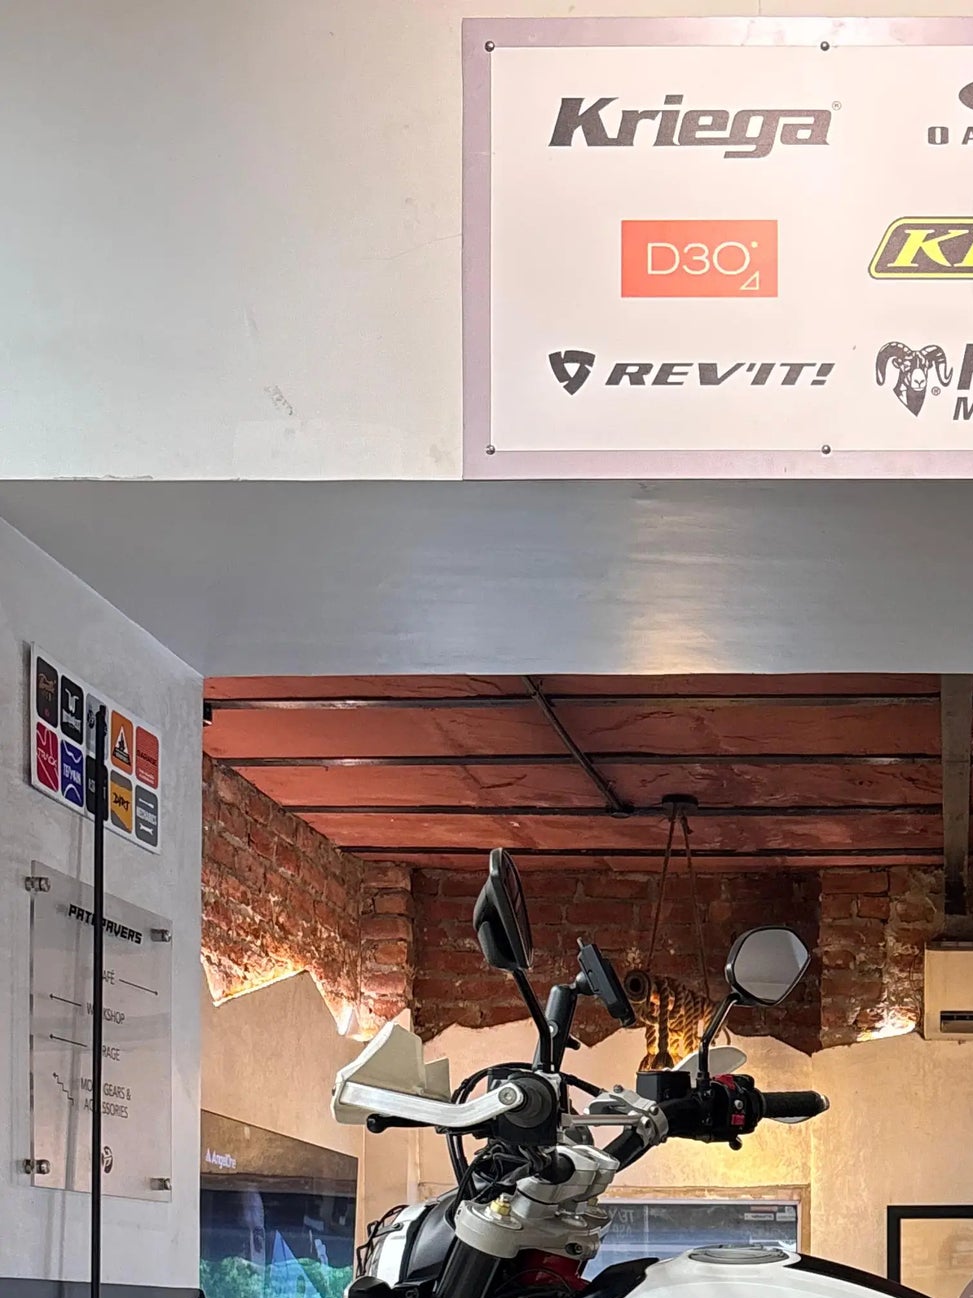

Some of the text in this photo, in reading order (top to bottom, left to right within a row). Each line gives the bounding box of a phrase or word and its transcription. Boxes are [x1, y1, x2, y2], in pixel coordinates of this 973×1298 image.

[548, 95, 831, 158] Kriega
[605, 363, 835, 385] REV'IT!
[86, 1002, 125, 1024] WKSHOP
[103, 1083, 125, 1099] GEARS
[126, 1089, 131, 1101] &
[84, 1099, 128, 1118] ACSSORIES
